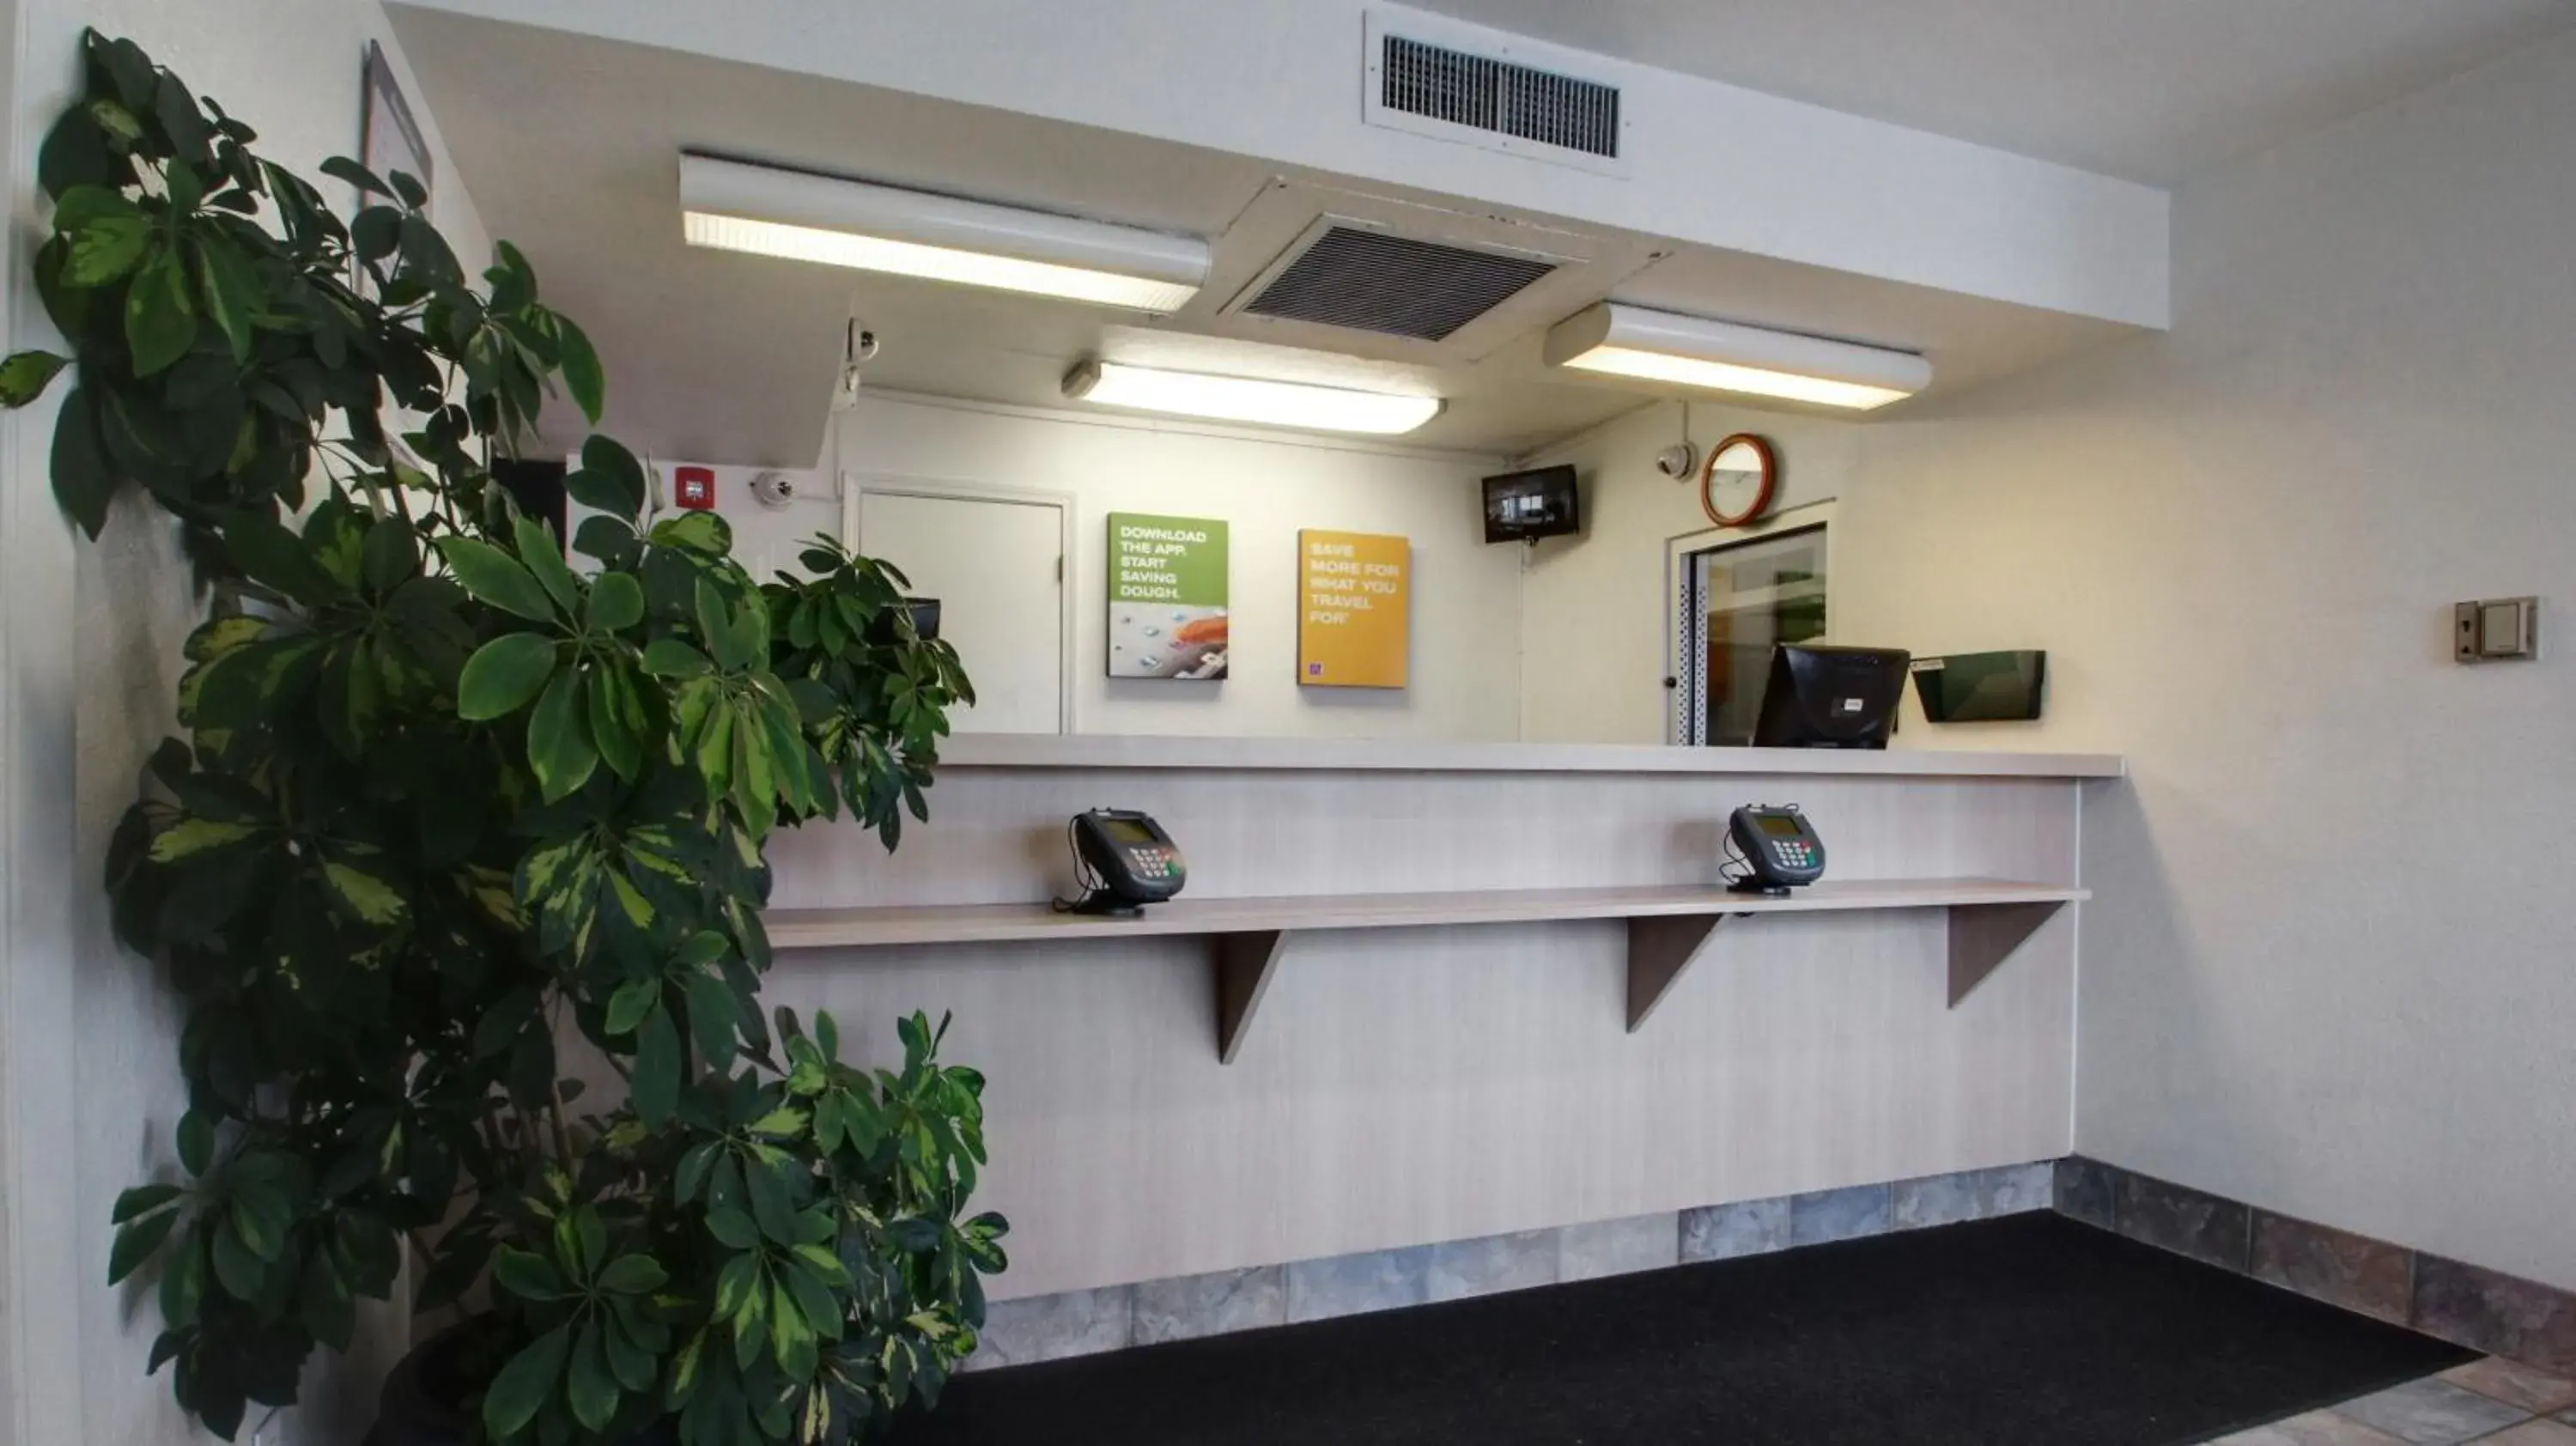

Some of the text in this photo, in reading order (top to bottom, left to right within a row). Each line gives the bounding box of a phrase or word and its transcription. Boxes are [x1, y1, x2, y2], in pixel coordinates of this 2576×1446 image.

[1121, 526, 1206, 543] DOWNLOAD
[1120, 541, 1151, 554] THE
[1309, 543, 1354, 557] SAVE
[1121, 556, 1167, 568] START
[1310, 559, 1399, 577] MORE FOR
[1121, 569, 1177, 584] SAVING
[1121, 585, 1181, 599] DOUGH.
[1310, 577, 1397, 595] WHAT YOU
[1310, 593, 1373, 611] TRAVEL
